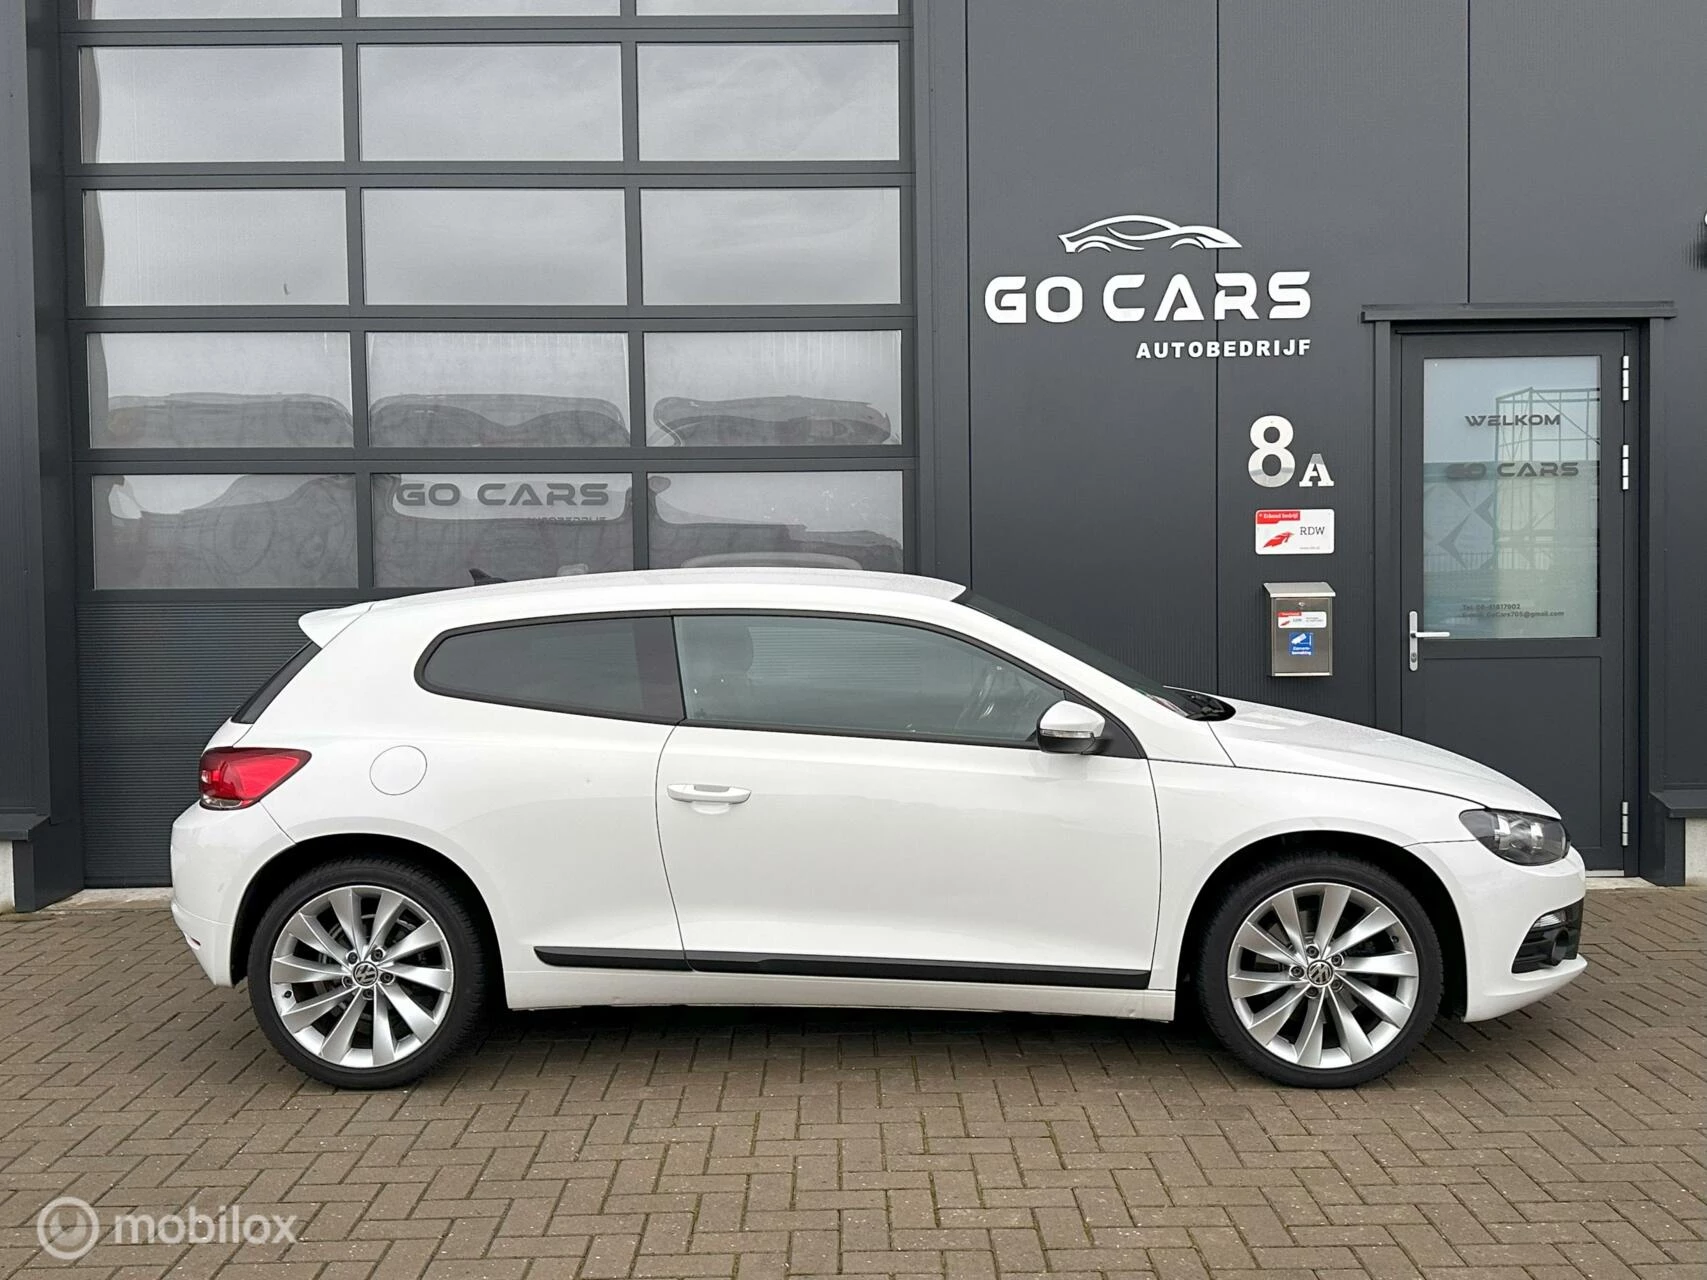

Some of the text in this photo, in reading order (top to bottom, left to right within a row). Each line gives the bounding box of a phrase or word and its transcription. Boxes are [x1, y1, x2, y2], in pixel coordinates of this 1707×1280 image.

[984, 271, 1311, 324] GO CARS
[1136, 339, 1311, 359] AUTOBEDRIJF
[1465, 414, 1560, 427] WELKOM
[1497, 462, 1579, 478] CARS
[396, 483, 609, 506] GO CARS
[1300, 526, 1325, 536] RDW
